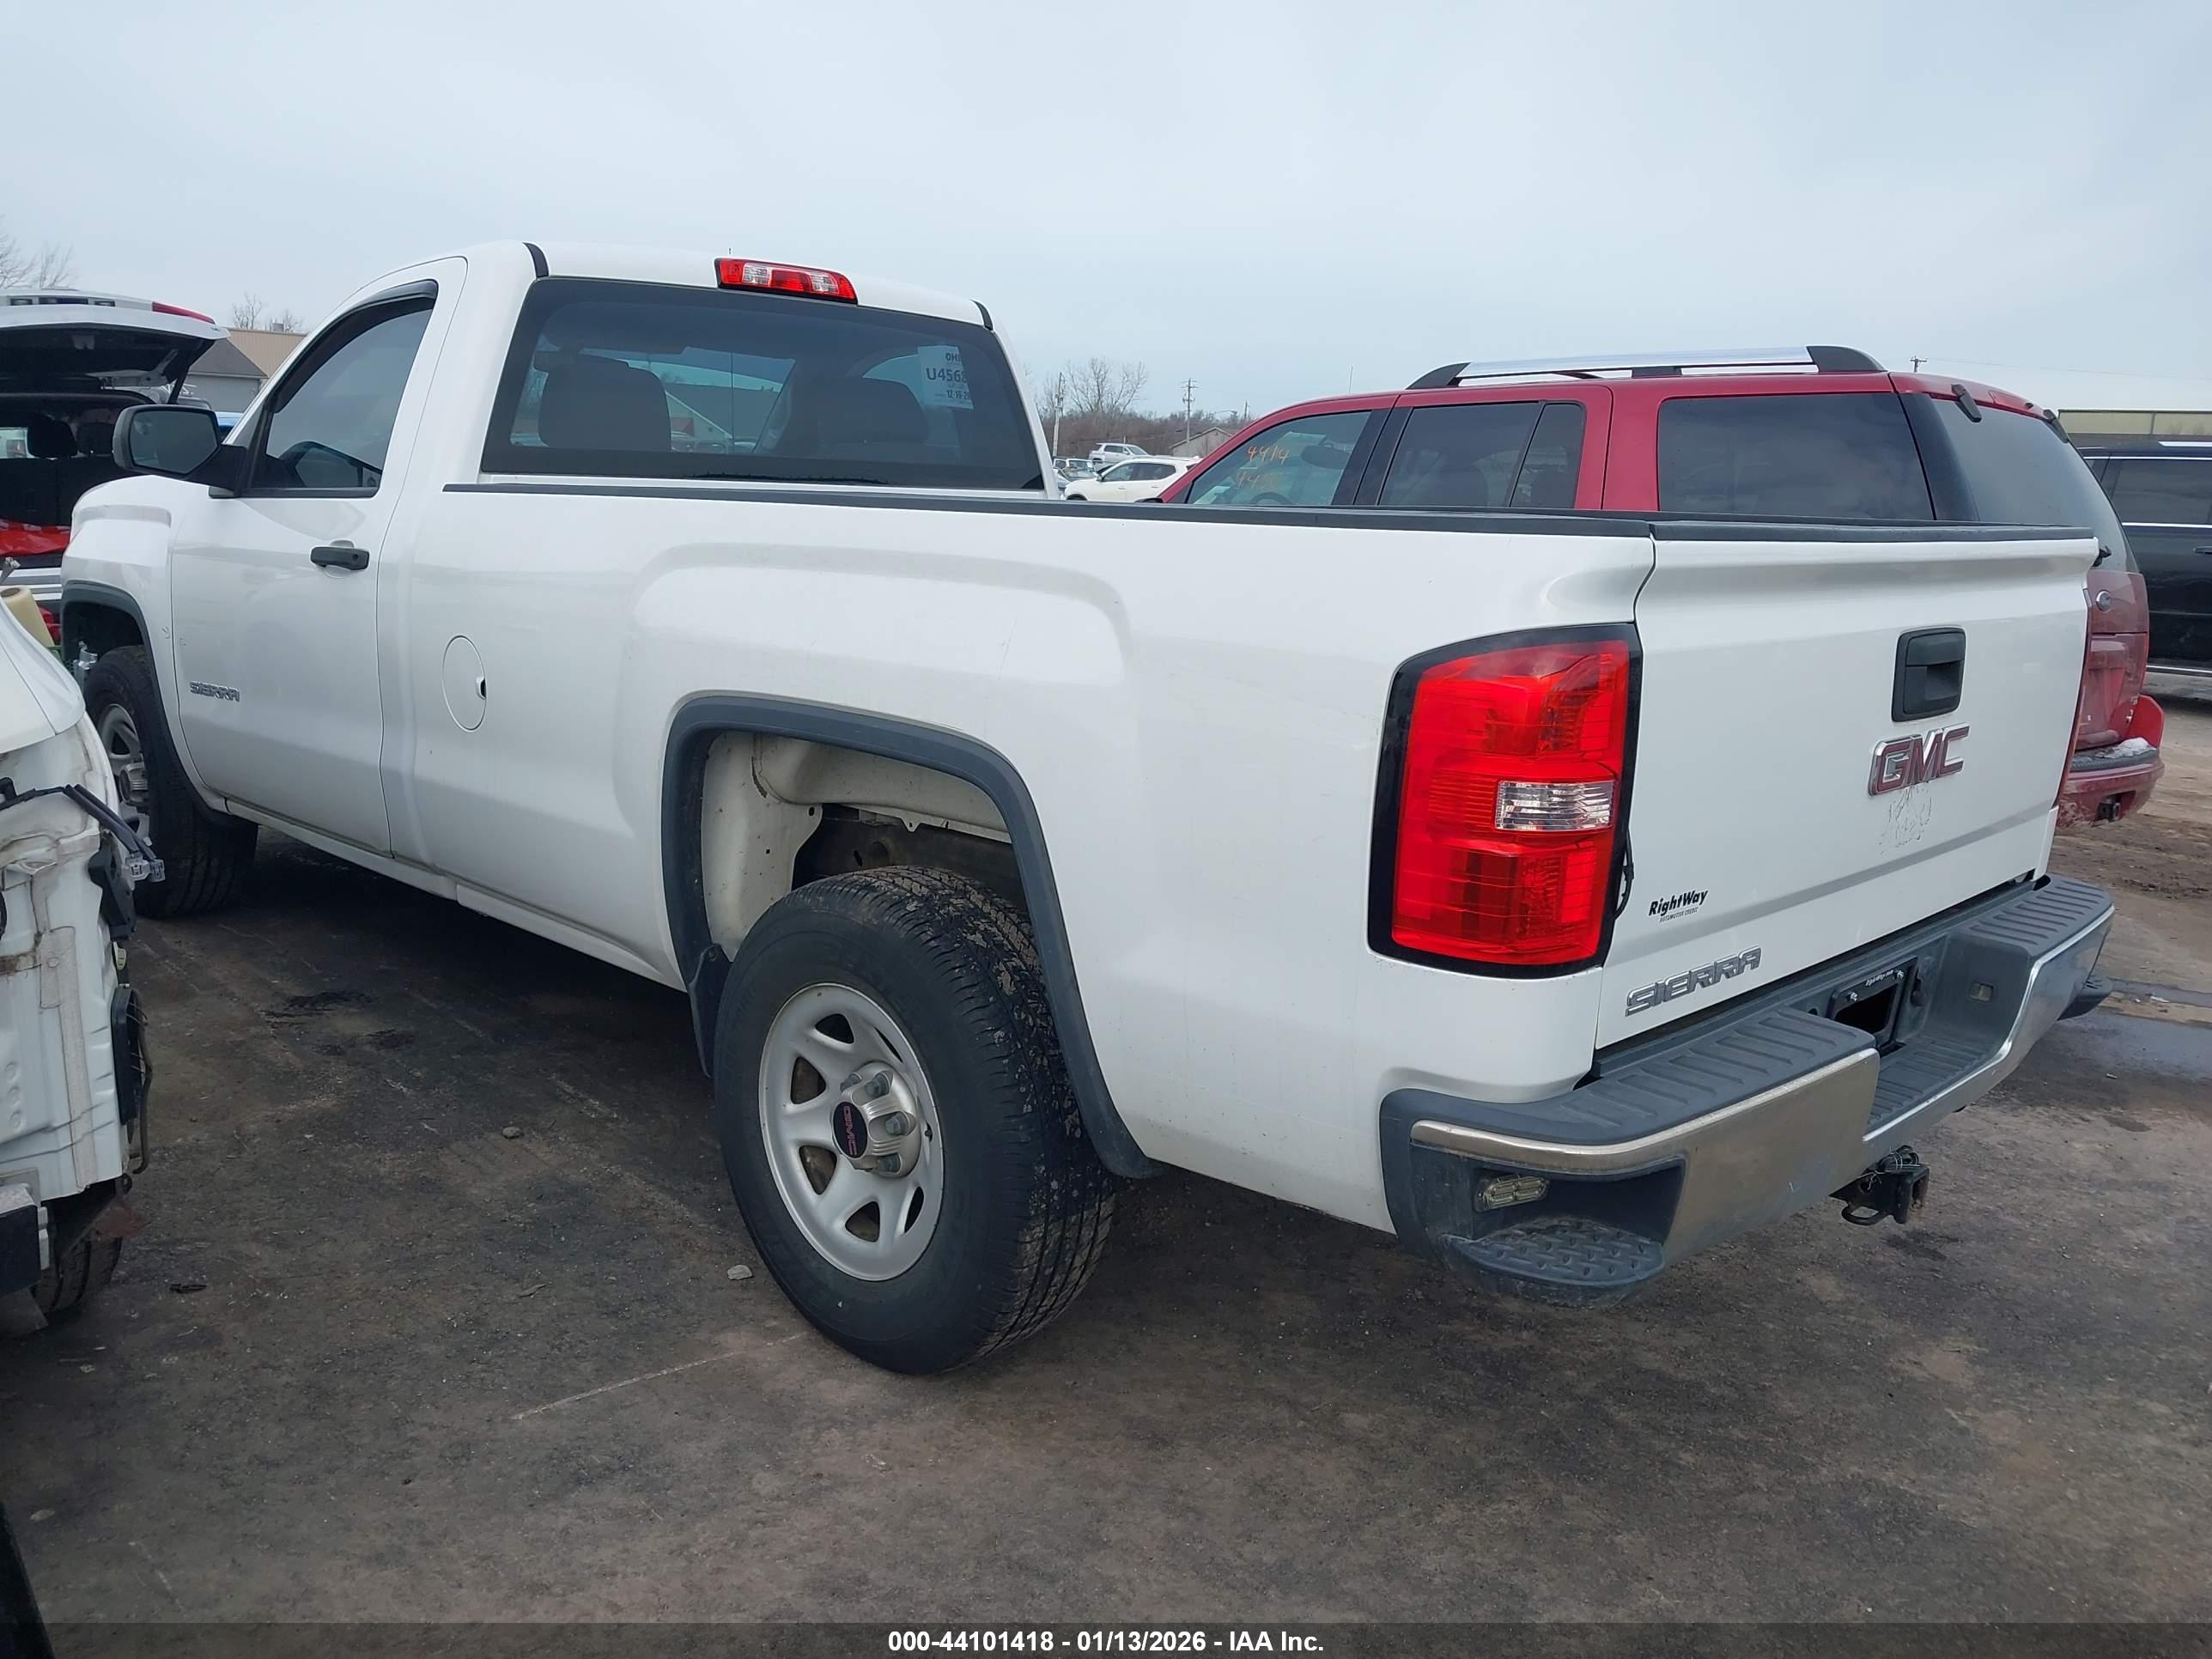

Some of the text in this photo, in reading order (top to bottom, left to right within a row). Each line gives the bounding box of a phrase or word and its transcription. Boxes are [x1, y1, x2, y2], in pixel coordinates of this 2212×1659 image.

[189, 680, 240, 702] SIERRA
[1868, 722, 1970, 796] GMC
[1649, 890, 1708, 916] RightWay
[1625, 945, 1762, 1017] SIERRA
[843, 1106, 857, 1155] GMC
